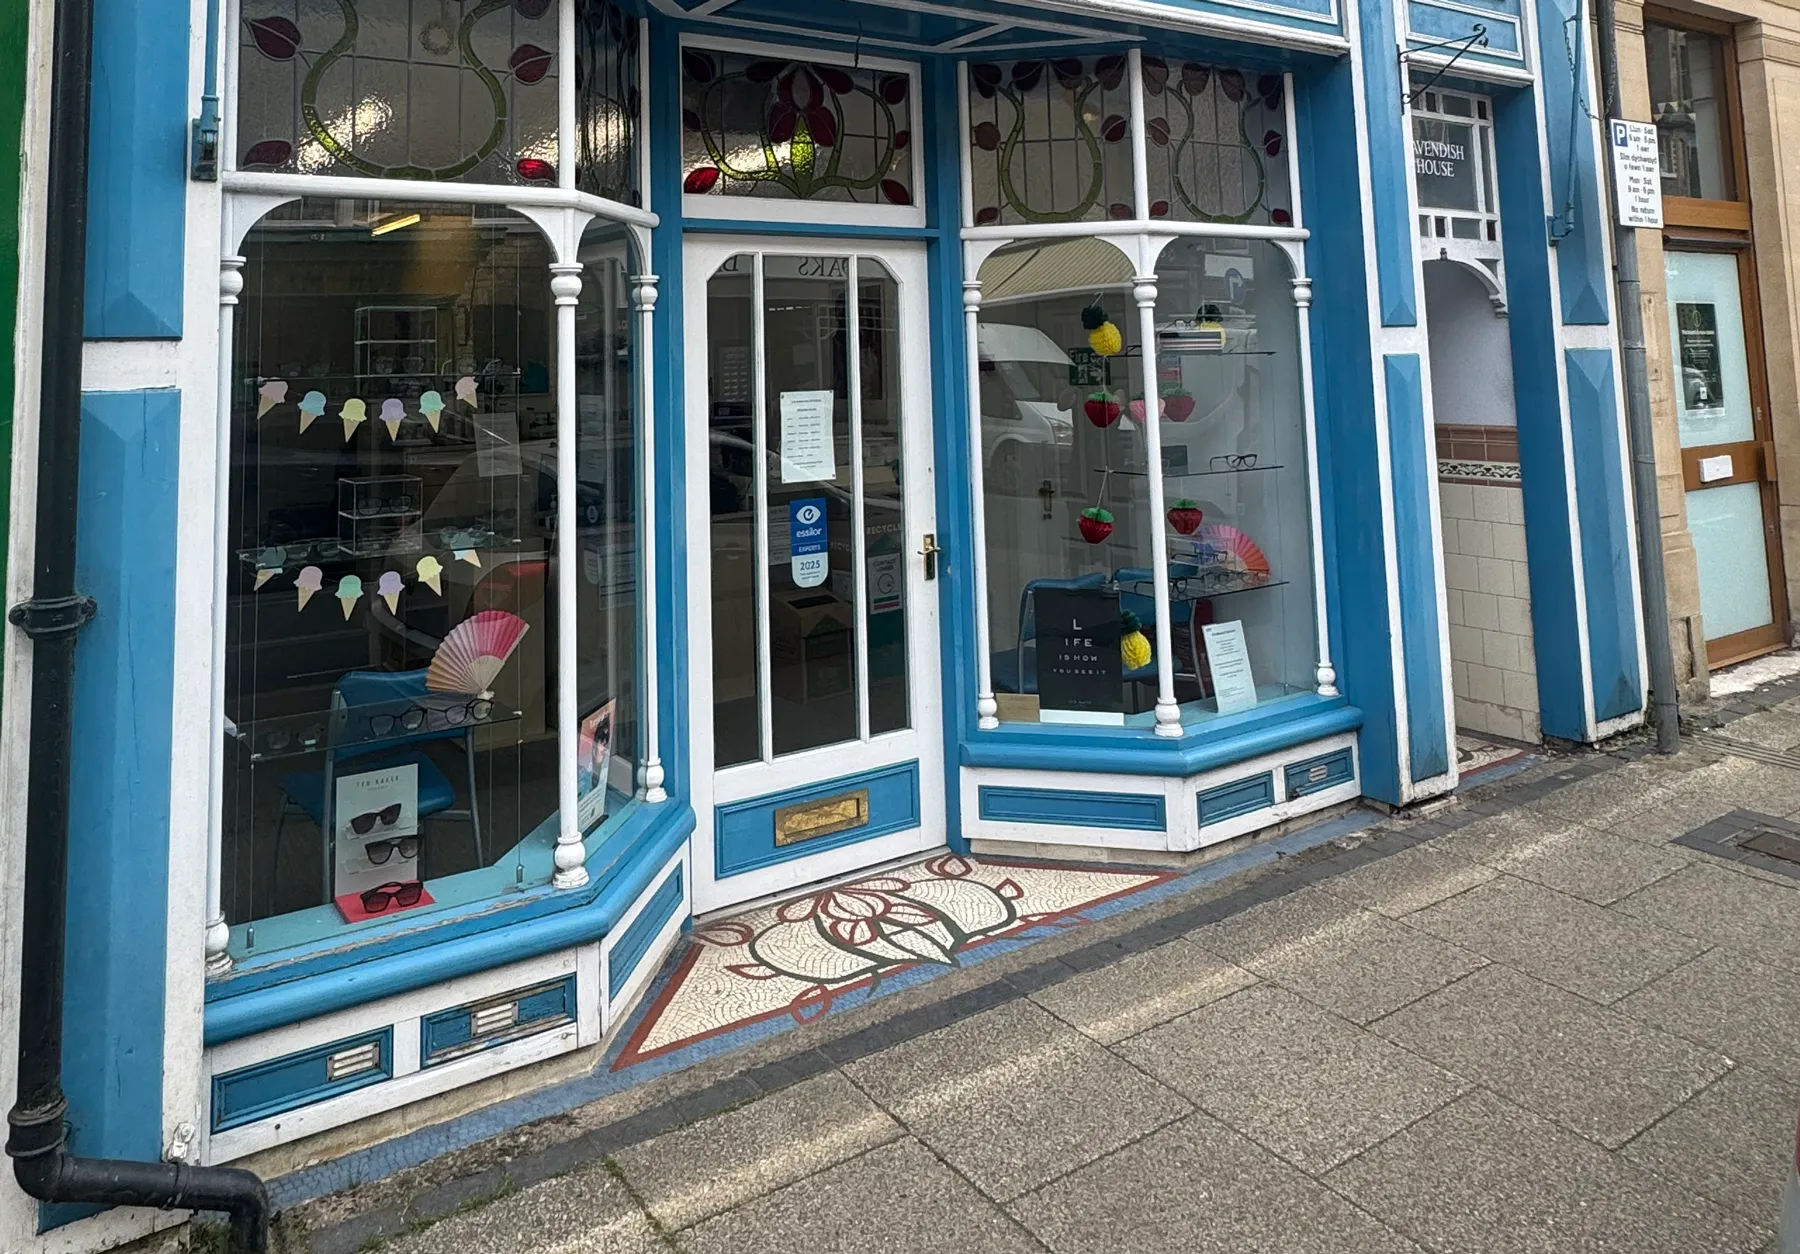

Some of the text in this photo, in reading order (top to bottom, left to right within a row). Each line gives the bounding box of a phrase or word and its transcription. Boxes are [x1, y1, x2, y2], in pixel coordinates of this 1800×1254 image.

[1616, 124, 1626, 145] P
[1412, 140, 1464, 160] AVENDISH
[1416, 158, 1454, 177] HOUSE
[796, 526, 823, 538] essilor
[800, 560, 821, 571] 2025
[1073, 618, 1082, 630] L
